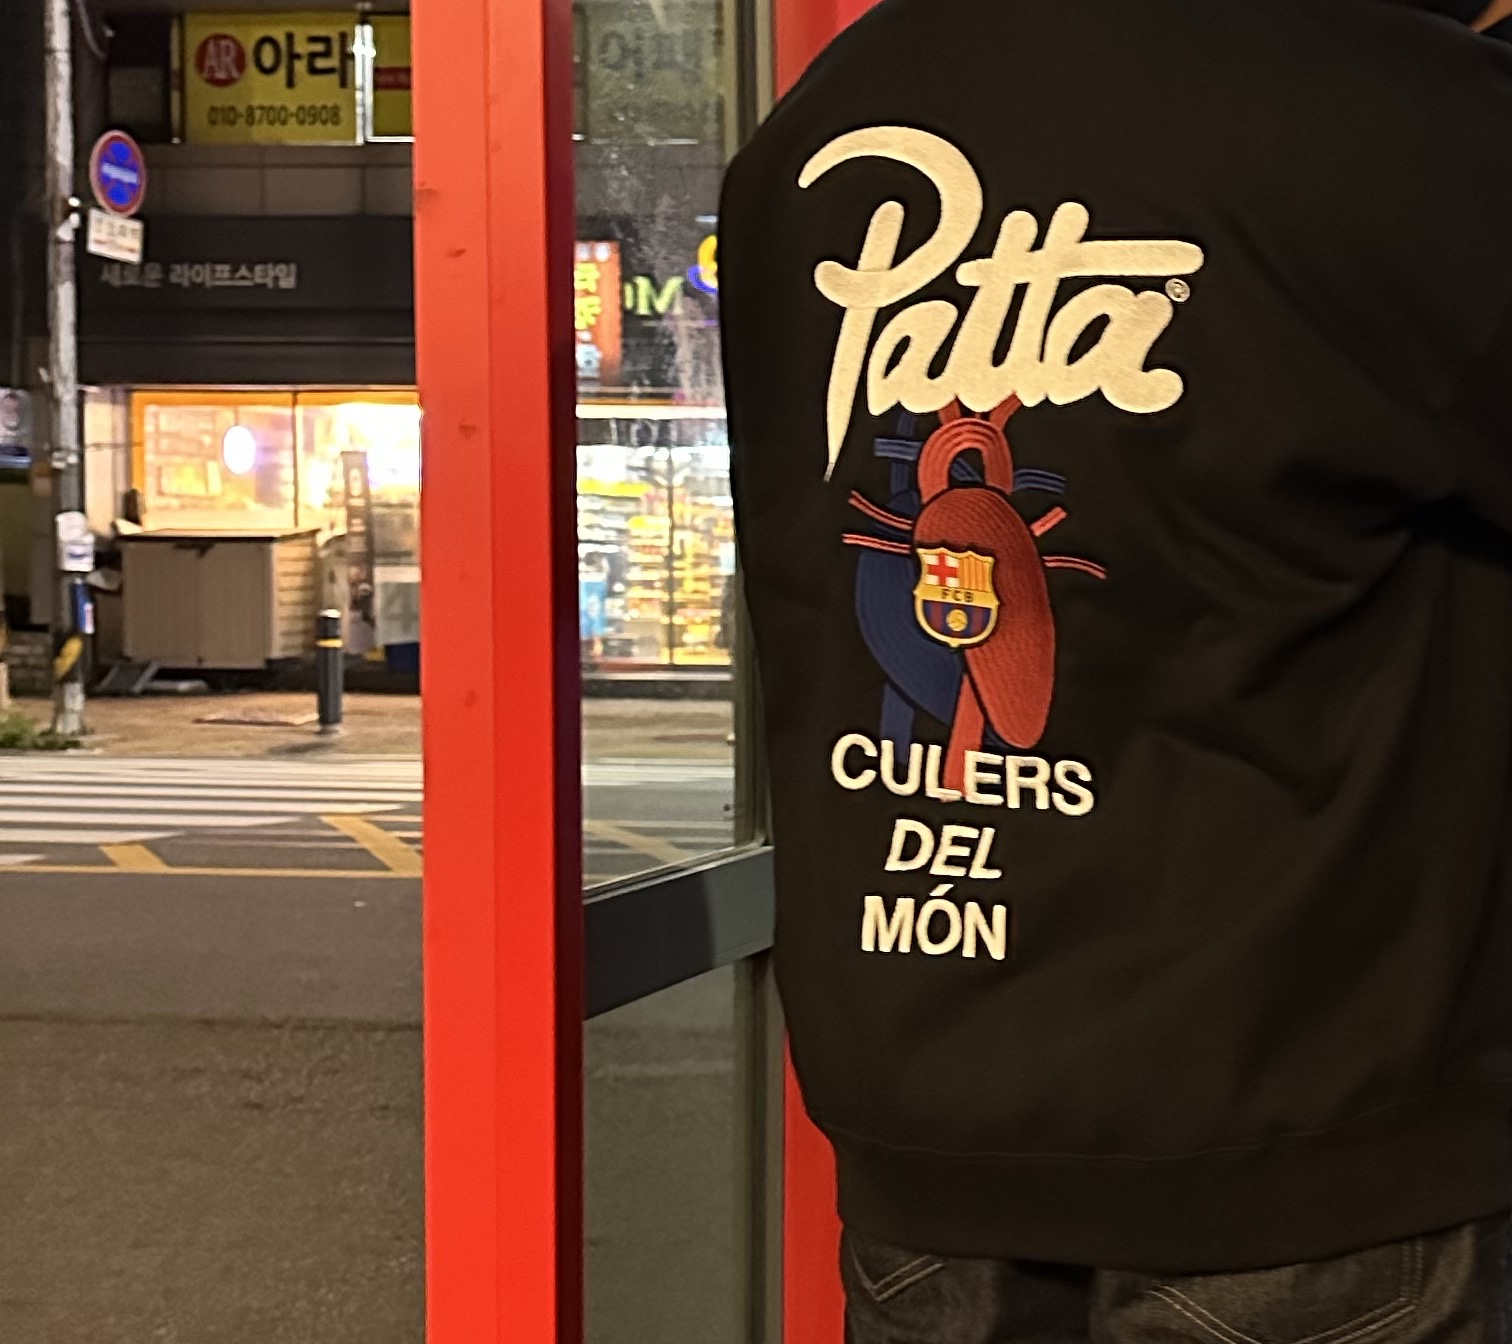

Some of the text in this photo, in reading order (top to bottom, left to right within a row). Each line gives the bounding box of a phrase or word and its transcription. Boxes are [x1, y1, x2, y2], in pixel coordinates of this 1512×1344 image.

[207, 106, 342, 126] 010-8700-0908
[168, 262, 296, 289] 라이프스타일
[798, 126, 1204, 482] Patta
[941, 588, 974, 604] FCB
[830, 733, 1095, 816] CULERS
[884, 819, 1002, 879] DEL
[861, 883, 1007, 960] MÓN
